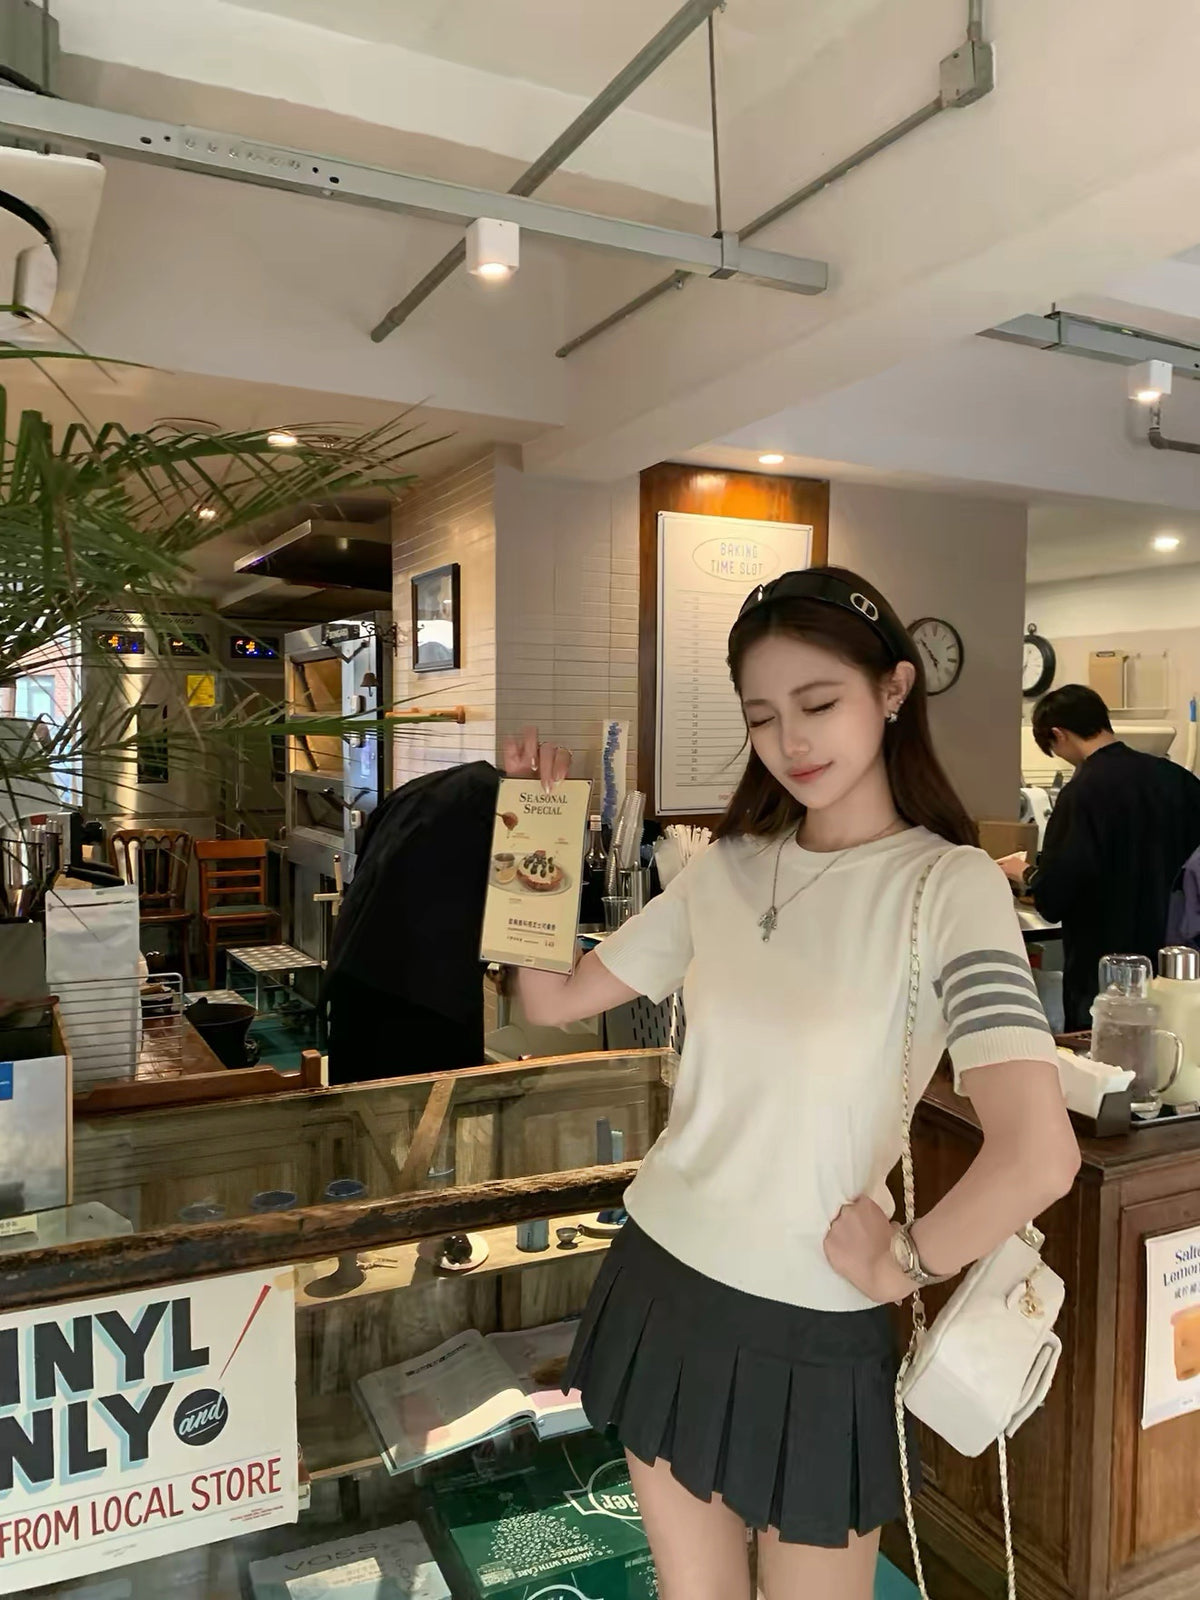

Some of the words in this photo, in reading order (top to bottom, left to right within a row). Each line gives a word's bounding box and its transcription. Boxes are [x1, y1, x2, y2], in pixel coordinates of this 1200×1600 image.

[720, 542, 758, 558] BAKING
[711, 560, 735, 575] TIME
[739, 562, 763, 576] SLOT
[519, 792, 568, 804] SEASONAL
[523, 804, 562, 815] SPECIAL
[0, 1297, 210, 1408] INYL
[0, 1382, 174, 1491] NLY
[178, 1387, 226, 1436] and
[0, 1505, 79, 1558] FROM
[91, 1484, 184, 1536] LOCAL
[191, 1458, 282, 1512] STORE
[284, 1543, 377, 1571] VOSS
[561, 1551, 593, 1564] HANDLE
[515, 1565, 538, 1578] CARE
[538, 1559, 562, 1572] WITH
